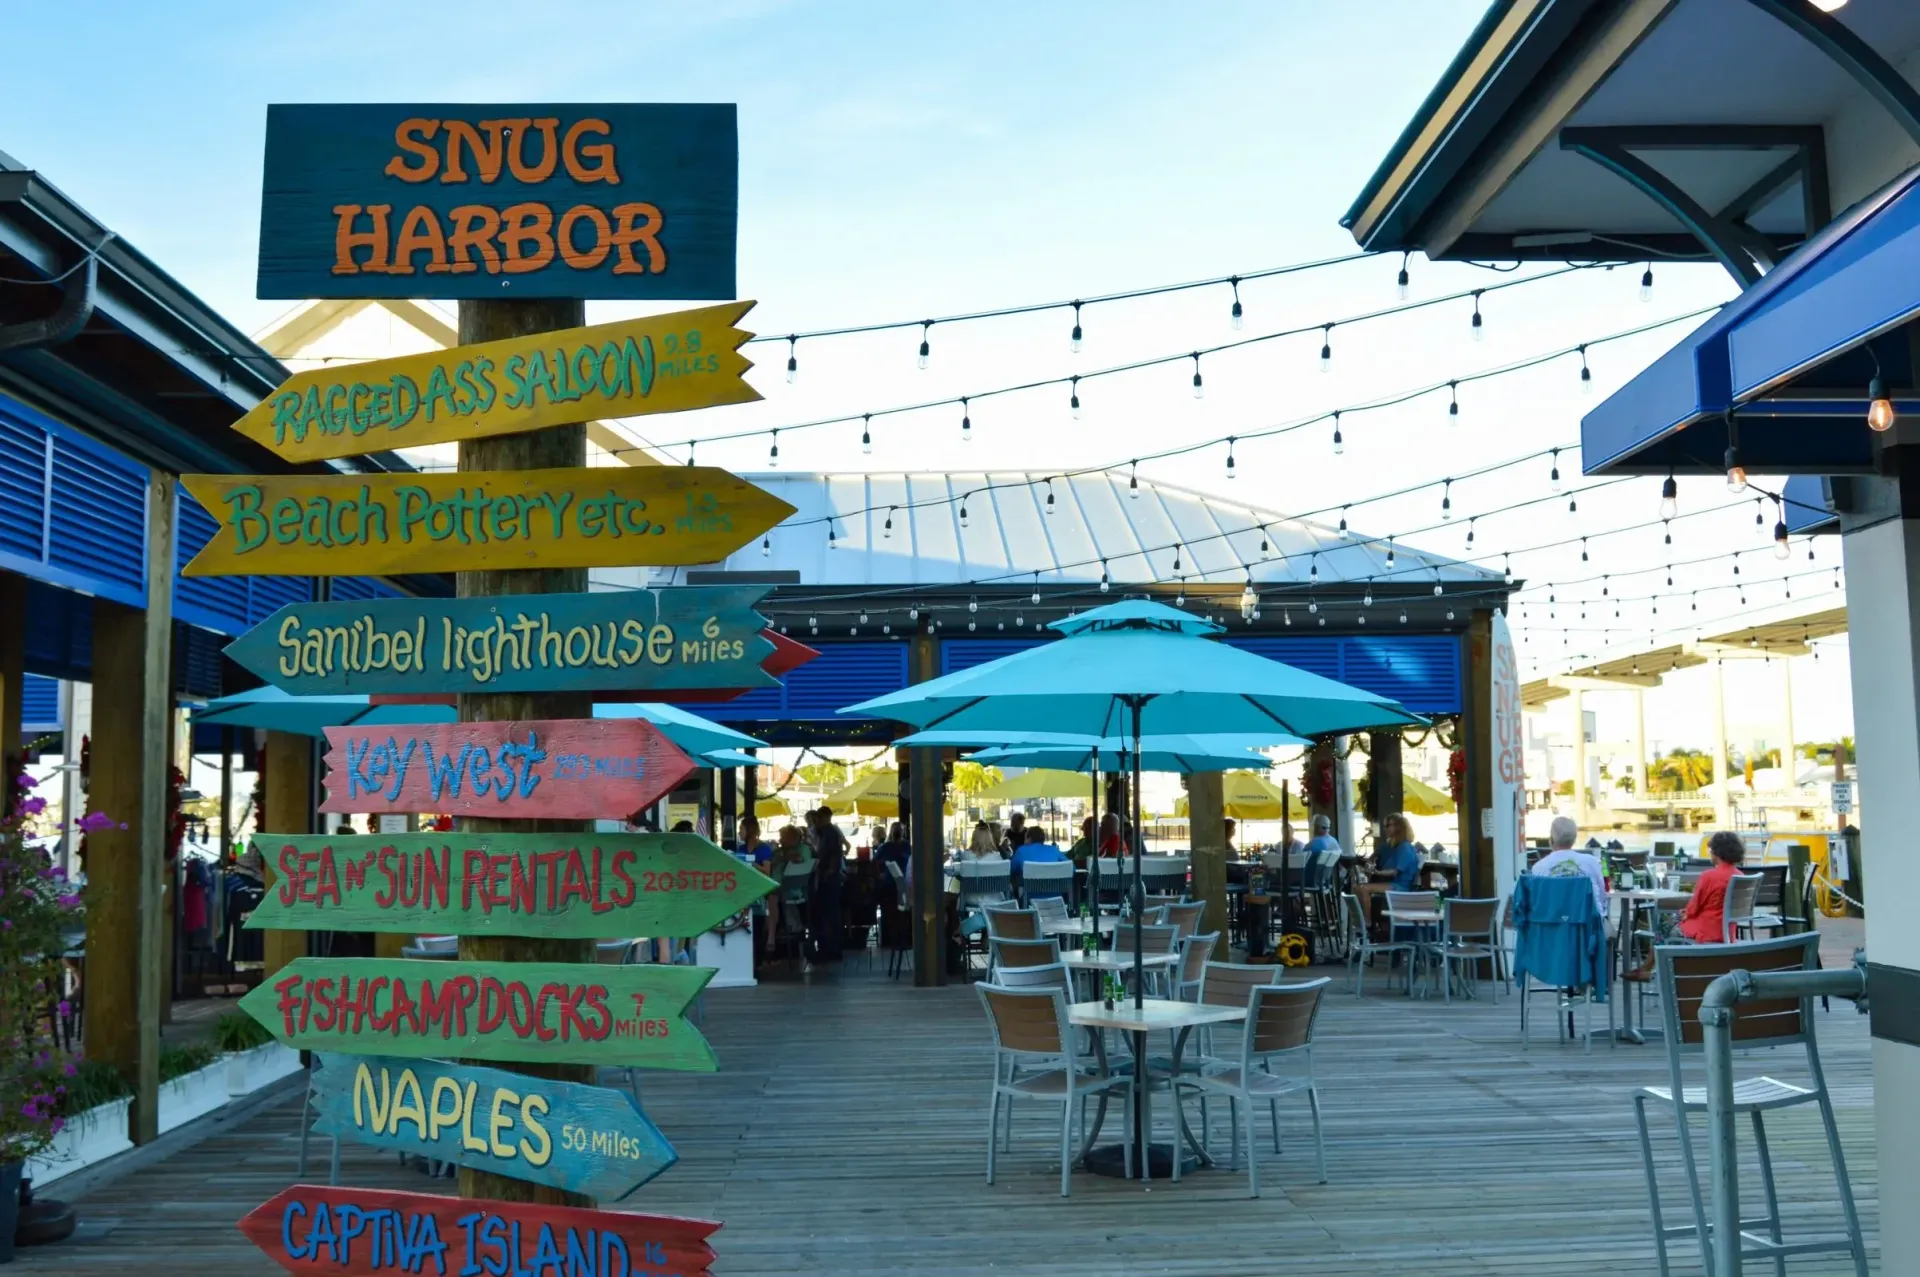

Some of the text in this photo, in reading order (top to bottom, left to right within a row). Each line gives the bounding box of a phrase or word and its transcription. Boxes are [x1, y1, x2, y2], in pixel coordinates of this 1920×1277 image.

[385, 118, 621, 184] SNUG
[332, 202, 667, 274] HARBOR
[269, 335, 656, 446] RAGGED ASS SALOON
[223, 485, 389, 555] Beach
[576, 489, 666, 539] etc.
[279, 612, 675, 682] Sanibel lighthouse
[682, 640, 744, 663] Miles
[702, 616, 720, 638] 6
[346, 736, 417, 801] Key
[421, 730, 547, 803] West
[279, 845, 341, 908] SEA
[462, 847, 637, 914] RENTALS
[631, 993, 645, 1017] 7
[354, 1062, 640, 1166] NAPLES 50 Miles
[456, 1212, 631, 1277] ISLAND
[645, 1241, 668, 1265] 16
